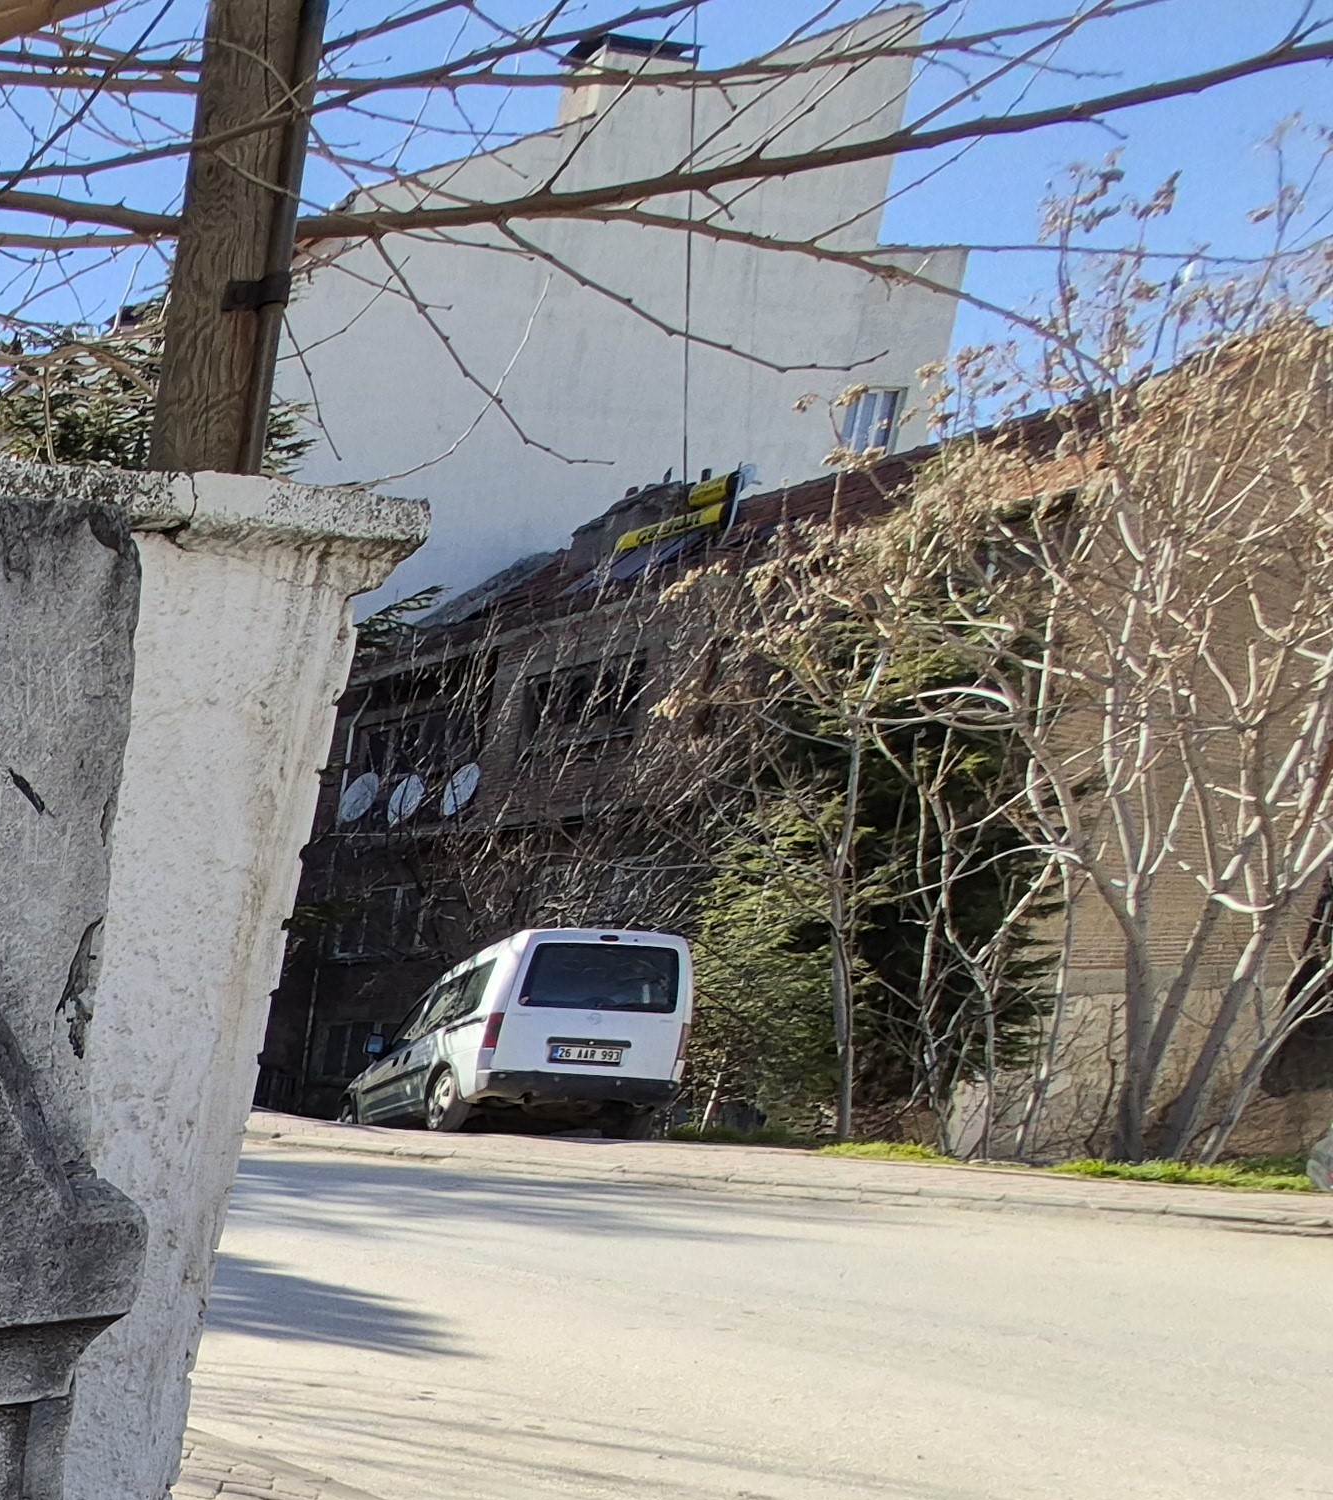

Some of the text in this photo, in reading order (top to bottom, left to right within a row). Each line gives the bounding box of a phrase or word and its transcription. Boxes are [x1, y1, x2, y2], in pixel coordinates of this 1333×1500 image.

[558, 1048, 620, 1061] 26 AAR 993
